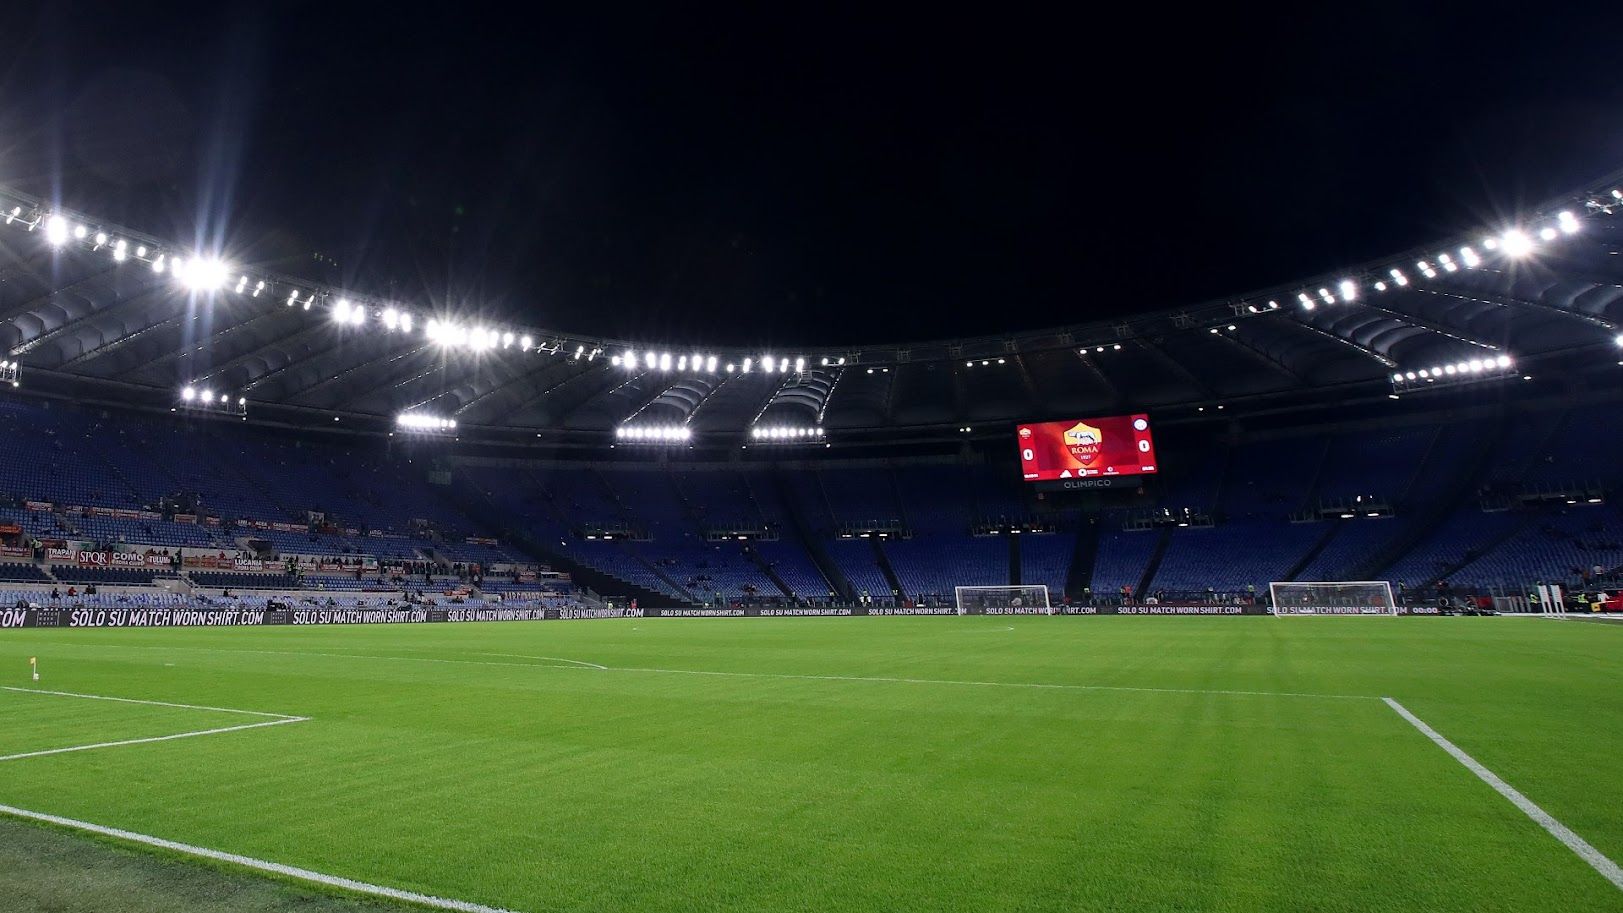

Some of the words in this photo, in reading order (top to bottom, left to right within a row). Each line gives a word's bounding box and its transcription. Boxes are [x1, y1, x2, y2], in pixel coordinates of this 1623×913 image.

[1023, 449, 1034, 460] 0
[1071, 446, 1099, 454] ROMA
[1063, 479, 1112, 489] OLIMPICO
[80, 551, 107, 565] SPQR
[112, 552, 144, 561] COMO
[560, 609, 573, 619] SOLO
[868, 608, 884, 616] SOLO
[986, 607, 1003, 615] SOLO
[1004, 607, 1014, 615] SU
[1117, 606, 1137, 614] SOLO
[1138, 606, 1149, 614] SU
[69, 610, 106, 626] SOLO
[108, 611, 126, 626] SU
[293, 611, 317, 625] SOLO
[318, 611, 332, 625] SU
[447, 610, 465, 622] SOLO
[466, 610, 476, 622] SU
